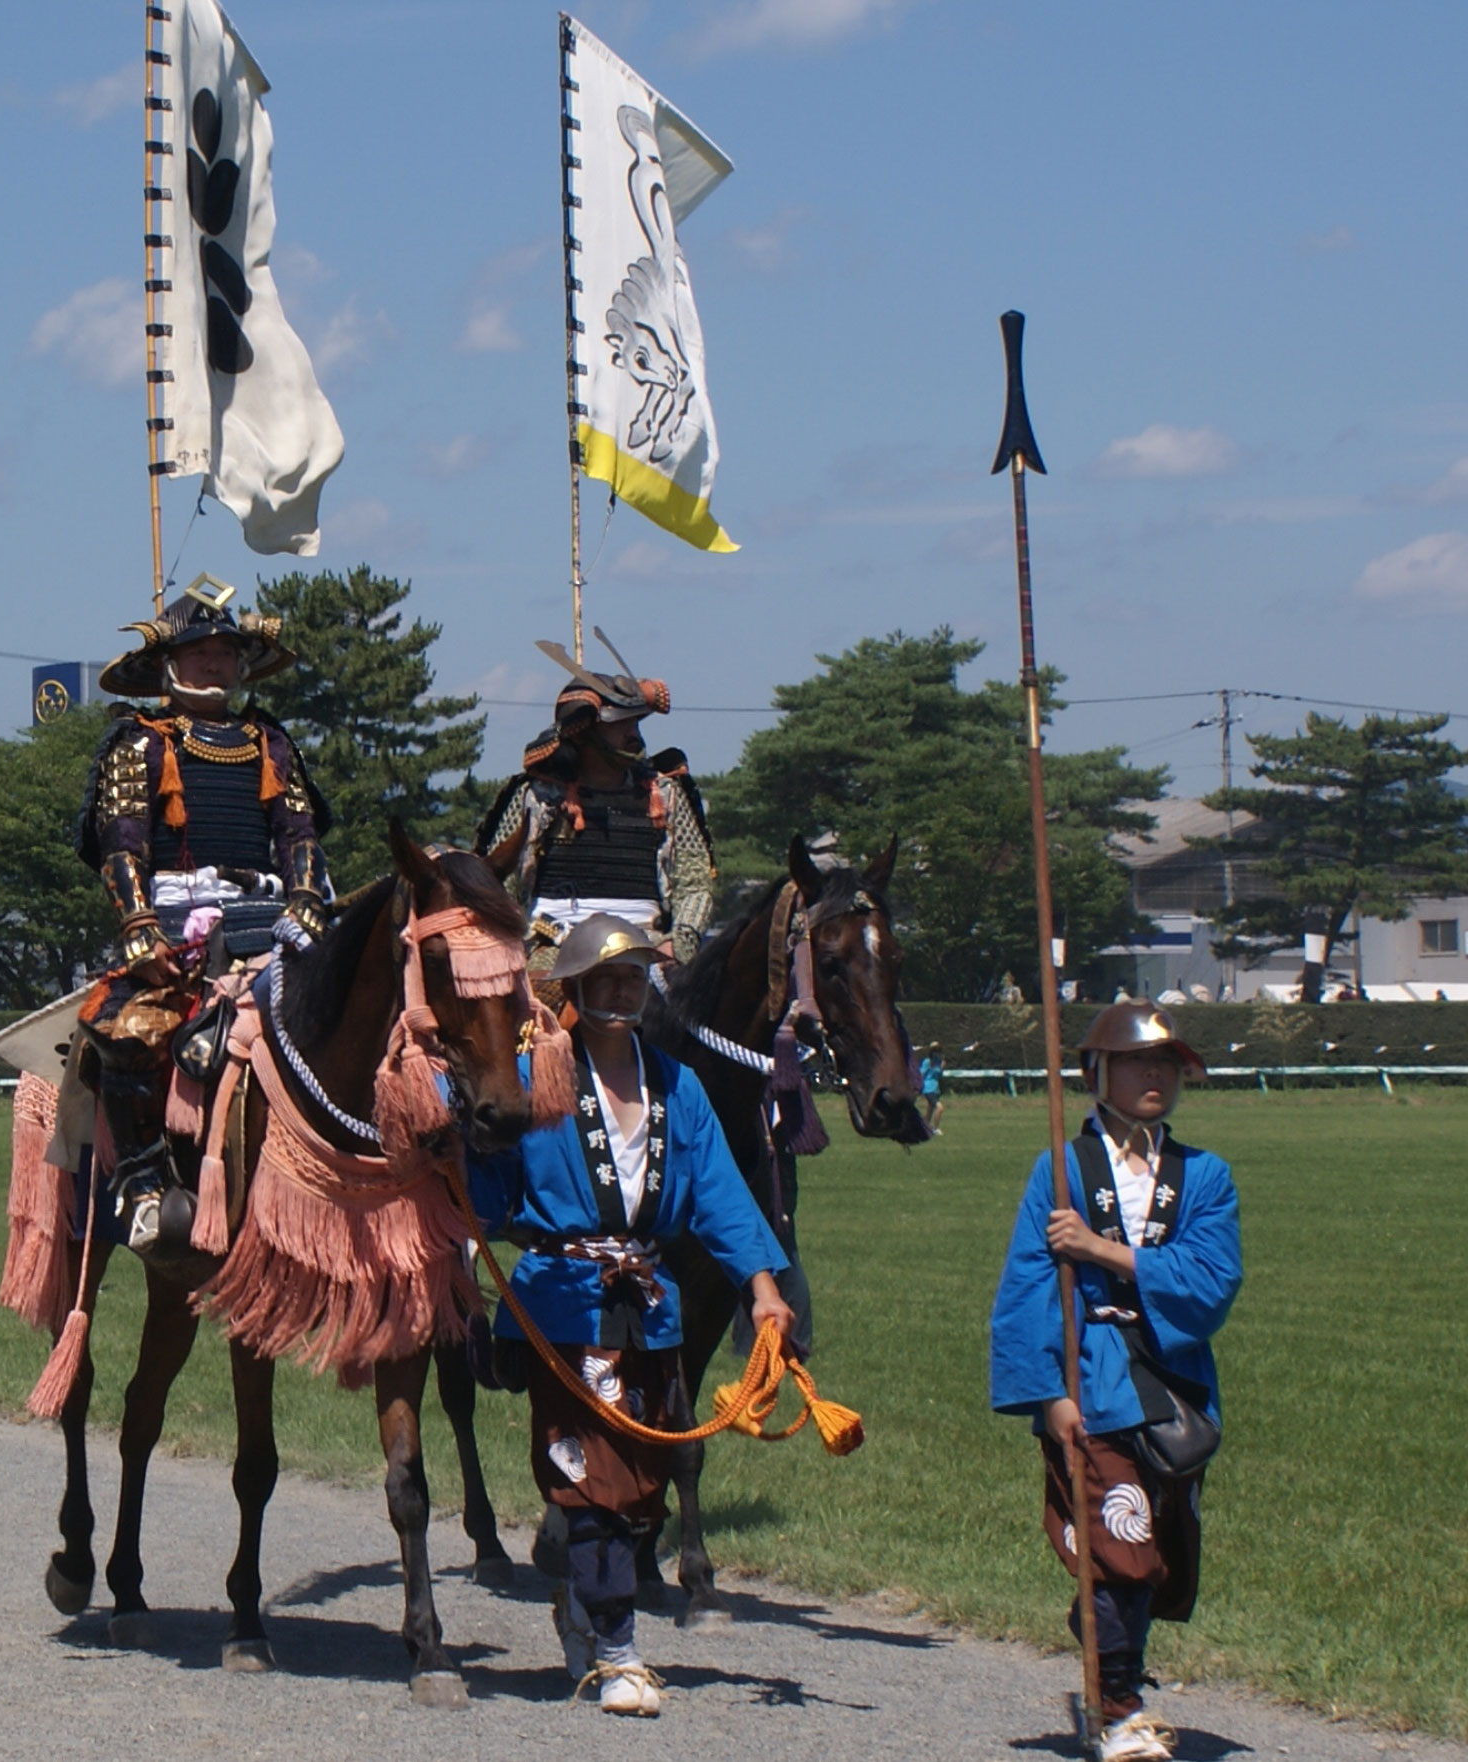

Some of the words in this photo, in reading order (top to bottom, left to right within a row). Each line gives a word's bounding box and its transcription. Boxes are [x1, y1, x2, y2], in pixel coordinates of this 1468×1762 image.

[580, 1094, 618, 1187] 宇野家
[646, 1101, 665, 1192] 宇野家
[1144, 1184, 1176, 1245] 宇野
